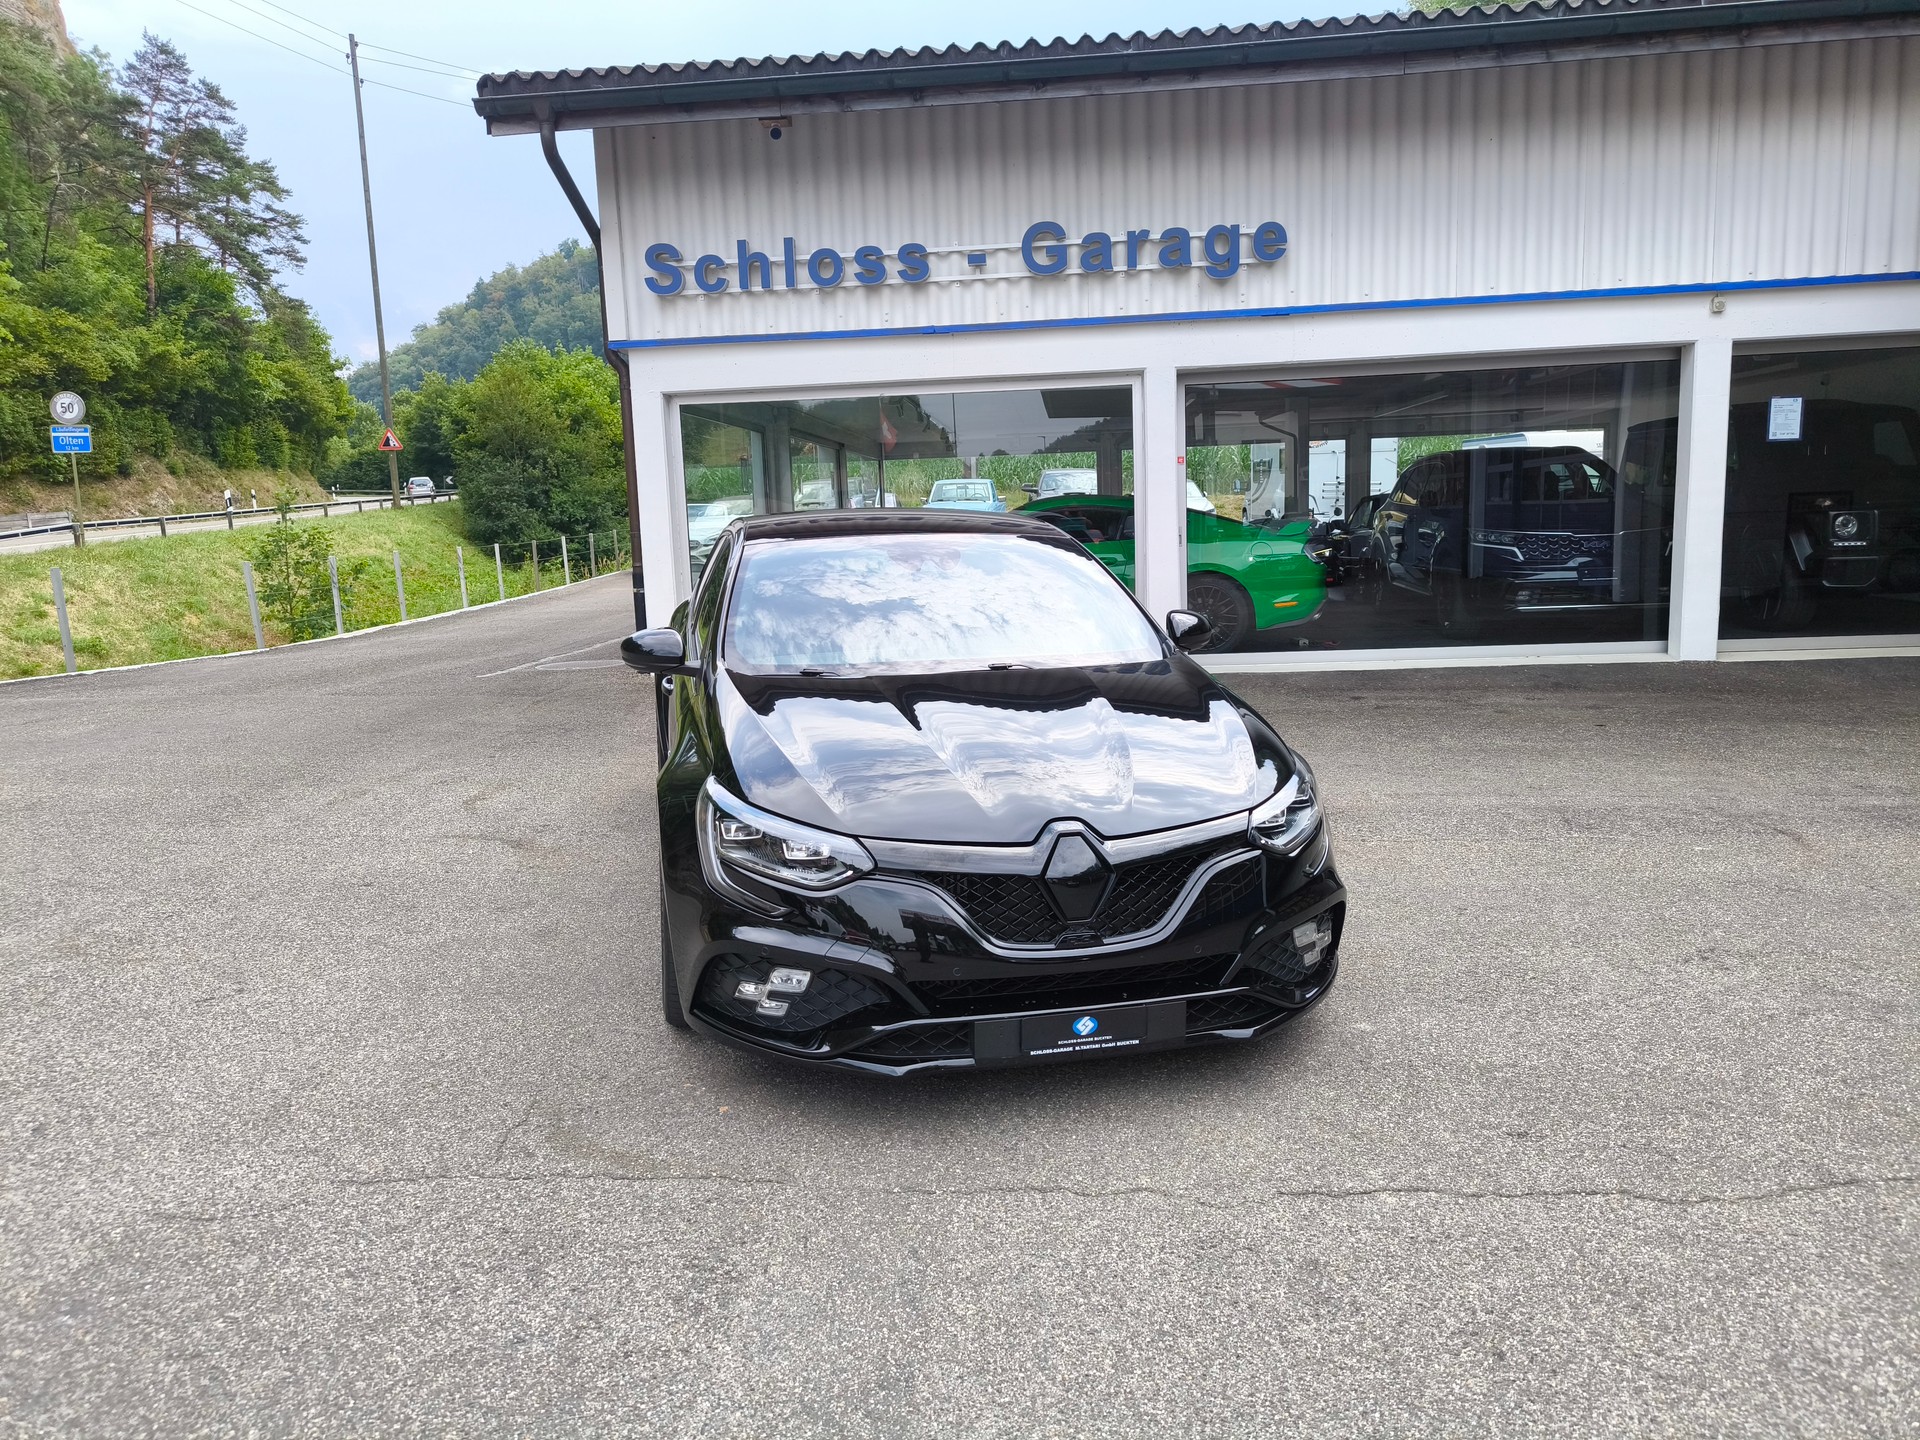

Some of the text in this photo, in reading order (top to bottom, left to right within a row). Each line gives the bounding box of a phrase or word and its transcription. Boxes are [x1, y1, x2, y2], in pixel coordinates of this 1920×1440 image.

[644, 220, 1288, 296] Schloss - Garage
[60, 402, 74, 413] 50
[59, 436, 84, 445] Olten
[1030, 1047, 1073, 1055] SCHLOSS-GARAGE
